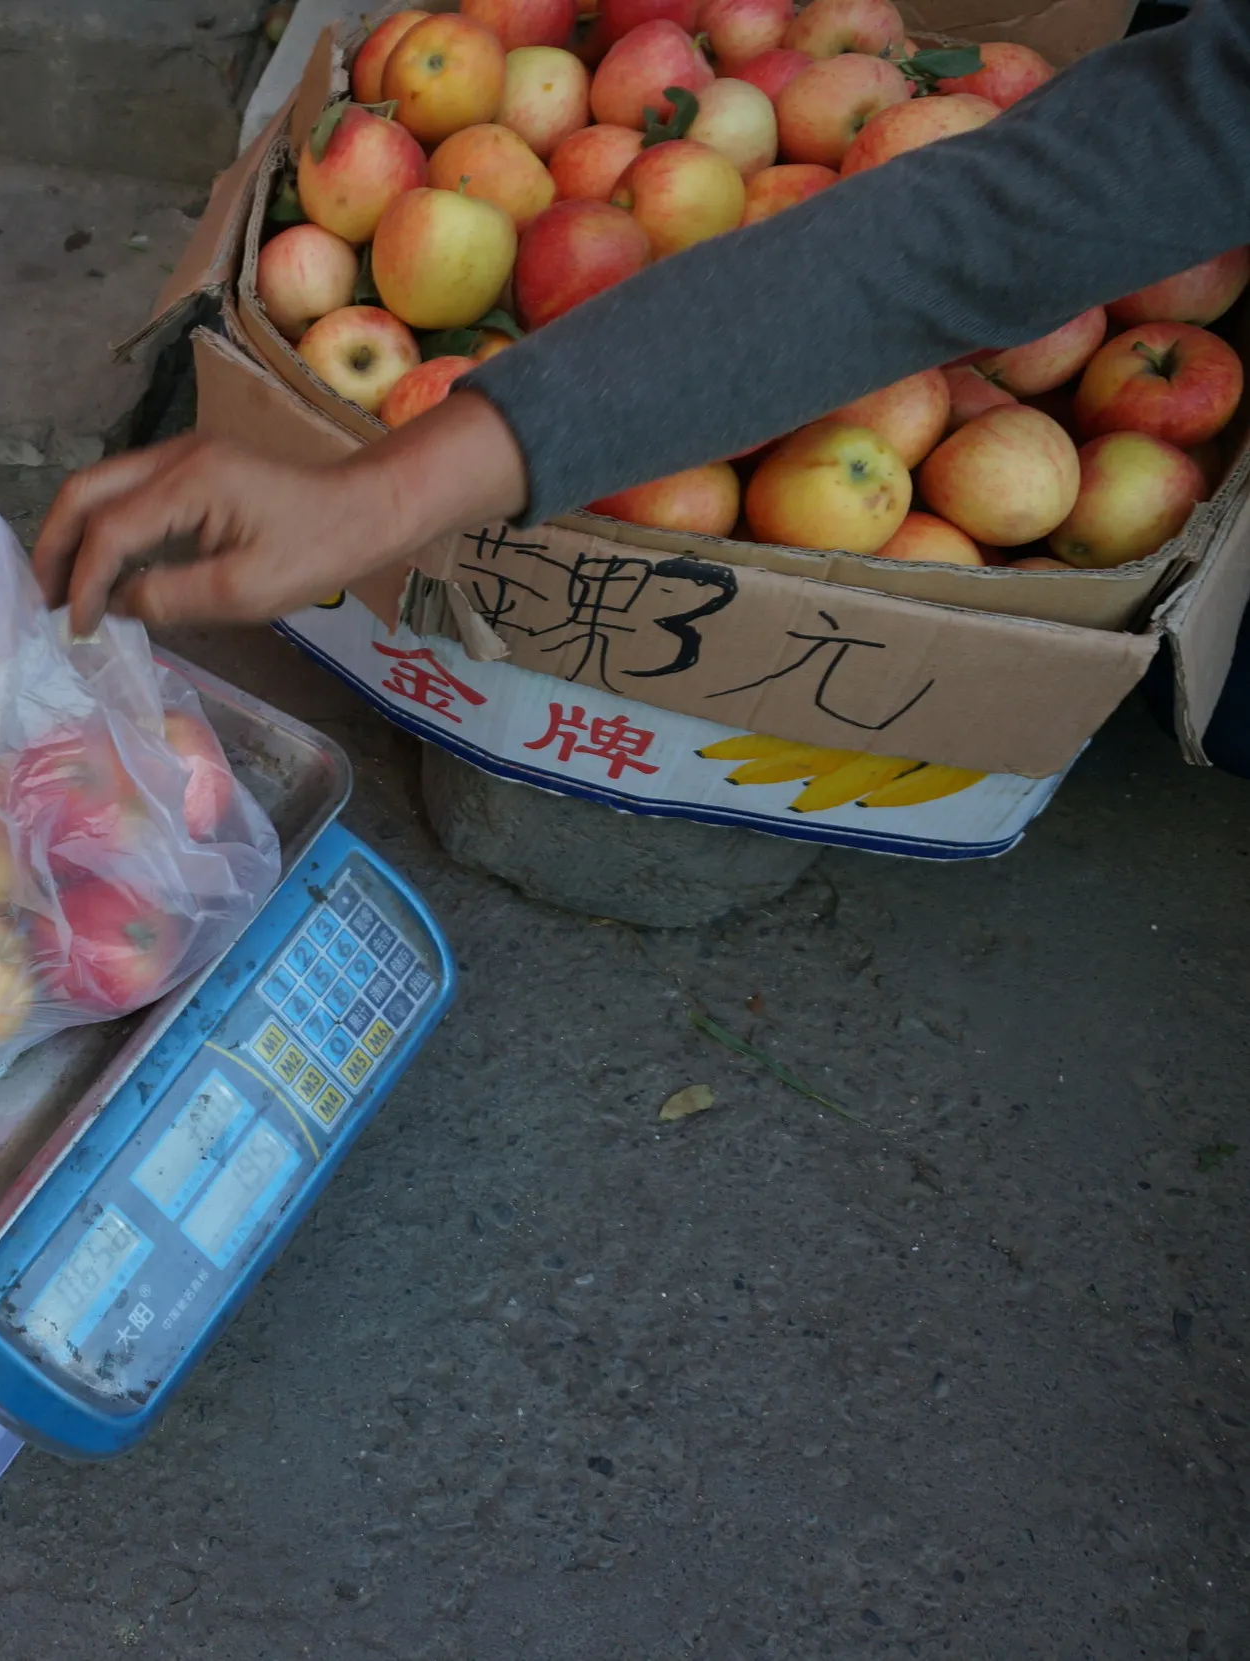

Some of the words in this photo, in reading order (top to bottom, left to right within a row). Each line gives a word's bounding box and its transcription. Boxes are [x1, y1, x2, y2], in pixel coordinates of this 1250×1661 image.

[371, 640, 660, 779] 金牌
[459, 527, 936, 731] 苹果3元
